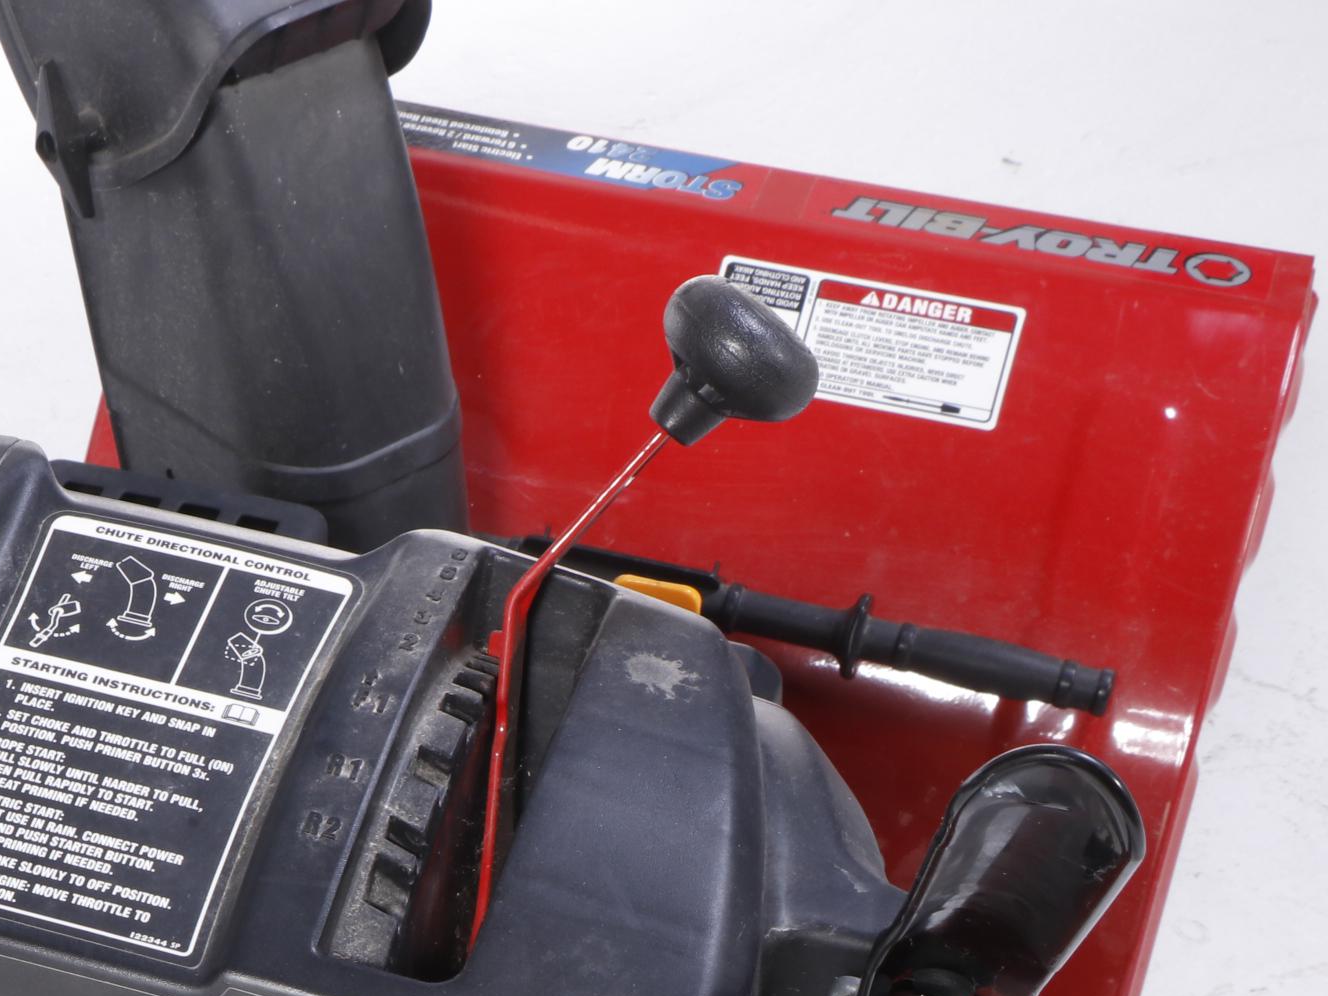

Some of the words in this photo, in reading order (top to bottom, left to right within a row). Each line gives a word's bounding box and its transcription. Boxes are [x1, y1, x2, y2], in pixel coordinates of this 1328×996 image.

[404, 123, 444, 135] Reverse
[421, 116, 448, 126] Steel
[450, 121, 507, 137] Reinforced
[452, 142, 477, 151] Start
[463, 133, 505, 147] Forward
[567, 136, 653, 162] 2410
[480, 148, 521, 159] Electric
[584, 157, 742, 200] STORM
[832, 196, 1178, 274] TROY-BILT
[752, 277, 781, 287] HANDS,
[755, 269, 789, 281] CLOTHING
[791, 275, 806, 283] AND
[763, 287, 802, 299] ROTATING
[783, 283, 804, 291] KEEP
[776, 299, 799, 308] AVOID
[881, 293, 974, 322] DANGER
[71, 553, 113, 568] DISCHARGE
[95, 526, 142, 542] CHUTE
[146, 537, 238, 564] DIRECTIONAL
[244, 559, 309, 580] CONTROL
[79, 561, 99, 570] LEFT
[161, 573, 204, 588] DISCHARGE
[168, 581, 192, 592] RIGHT
[254, 579, 305, 596] ADJUSTABLE
[253, 585, 281, 597] CHUTE
[282, 592, 299, 601] TILT
[11, 656, 87, 681] STARTING
[92, 675, 214, 711] INSTRUCTIONS:
[6, 679, 15, 689] 1.
[20, 682, 62, 699] INSERT
[62, 692, 114, 712] IGNITION
[115, 704, 141, 718] KEY
[140, 711, 167, 724] AND
[167, 717, 200, 732] SNAP
[201, 725, 216, 737] IN
[14, 693, 54, 711] PLACE.
[0, 720, 56, 742] POSITION.
[60, 734, 94, 751] PUSH
[94, 743, 142, 763] PRIMER
[142, 755, 191, 775] BUTTON
[191, 767, 209, 780] 3x.
[6, 709, 30, 722] SET
[30, 715, 70, 732] CHOKE
[70, 725, 96, 738] AND
[92, 730, 158, 753] THROTTLE
[158, 745, 176, 761] TO
[172, 750, 205, 766] FULL
[208, 758, 233, 775] (ON)
[25, 744, 65, 762] START:
[327, 753, 363, 781] R1
[13, 767, 41, 783] PULL
[44, 775, 95, 795] RAPIDLY
[97, 788, 113, 800] TO
[114, 793, 153, 811] START.
[17, 755, 65, 774] SLOWLY
[65, 767, 98, 784] UNTIL
[101, 776, 150, 797] HARDER
[152, 788, 169, 801] TO
[169, 793, 202, 812] PULL,
[20, 783, 73, 804] PRIMING
[74, 796, 89, 807] IF
[88, 799, 138, 821] NEEDED.
[23, 802, 64, 820] START:
[304, 811, 341, 840] R2
[5, 811, 30, 825] USE
[30, 817, 45, 829] IN
[45, 821, 77, 838] RAIN.
[81, 830, 138, 852] CONNECT
[138, 845, 183, 865] POWER
[15, 827, 49, 844] PUSH
[49, 836, 103, 858] STARTER
[104, 849, 154, 872] BUTTON.
[48, 849, 63, 860] IF
[63, 853, 113, 875] NEEDED.
[18, 860, 67, 881] SLOWLY
[68, 873, 85, 886] TO
[86, 878, 112, 892] OFF
[112, 884, 171, 909] POSITION.
[31, 883, 69, 901] MOVE
[71, 893, 132, 918] THROTTLE
[134, 909, 151, 922] TO
